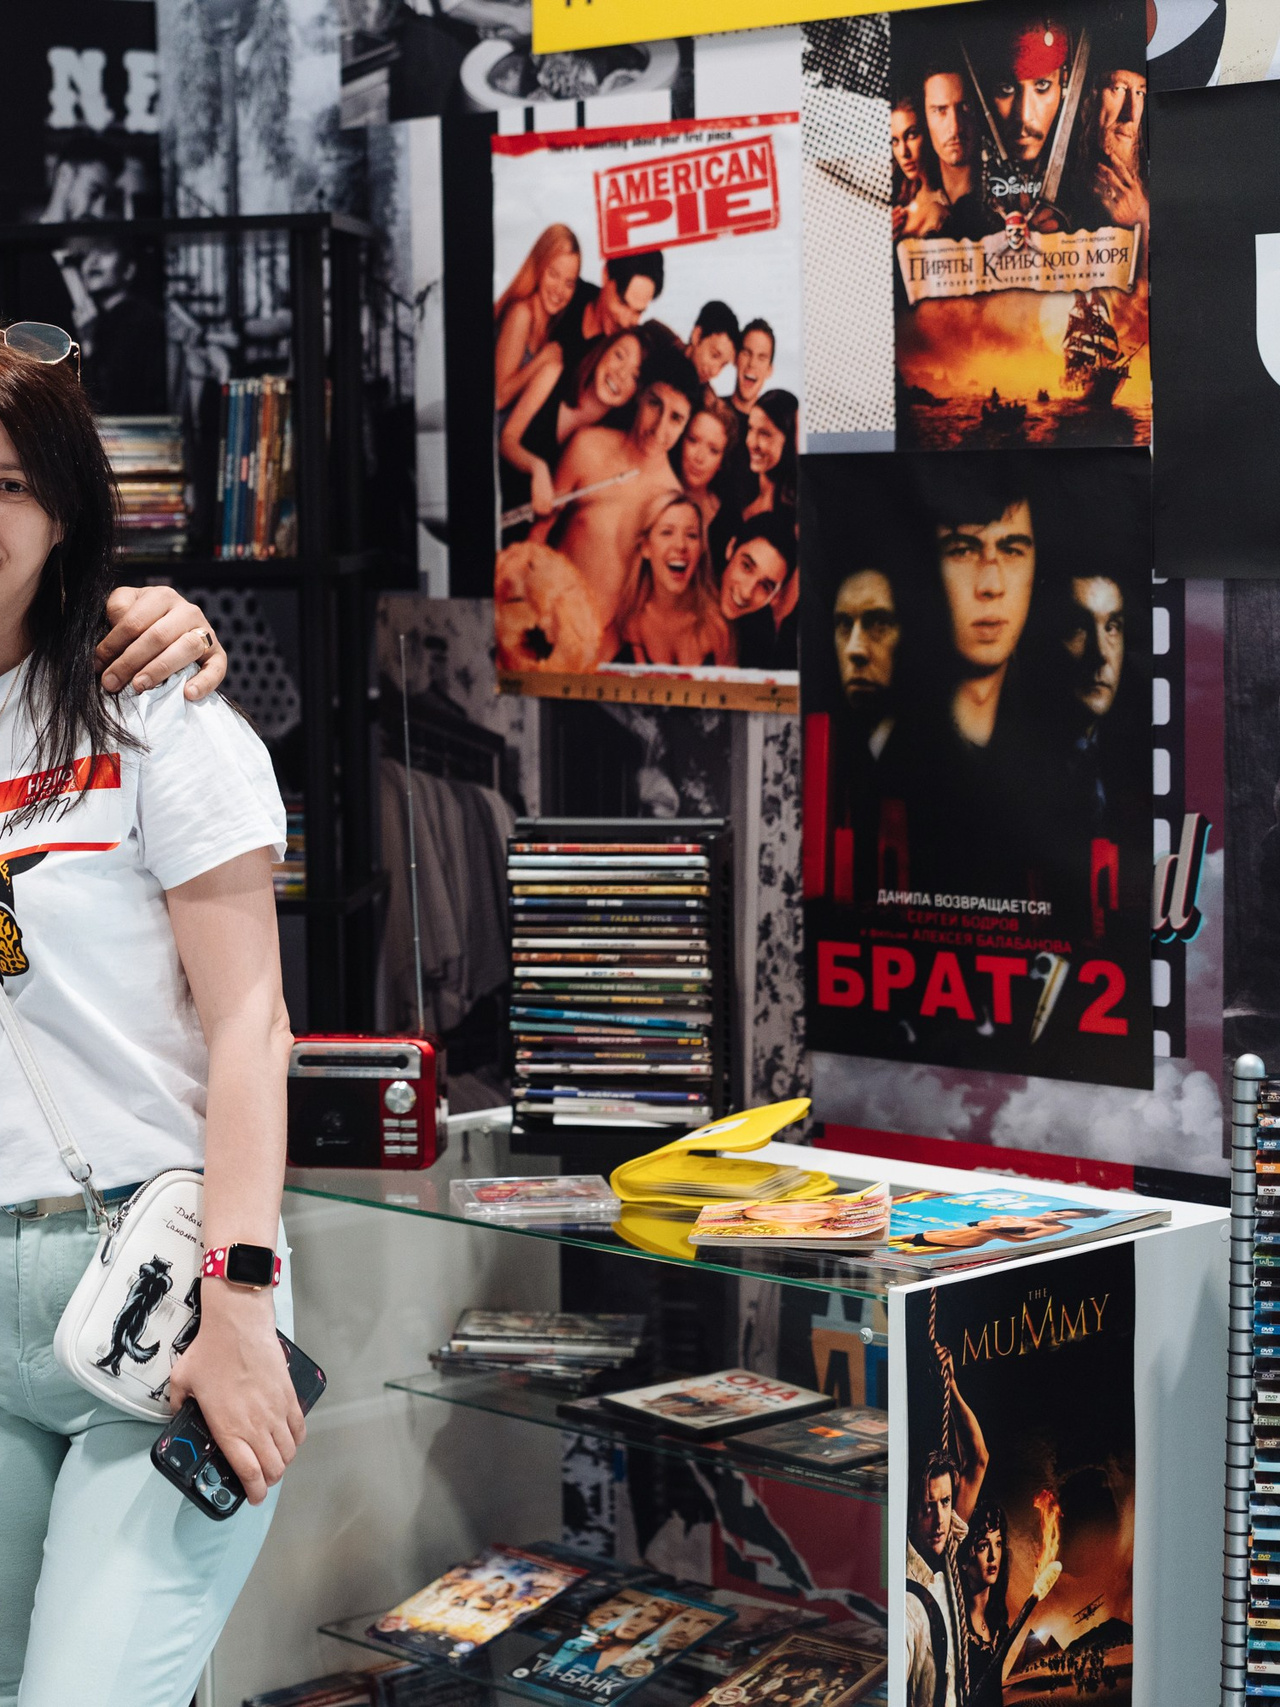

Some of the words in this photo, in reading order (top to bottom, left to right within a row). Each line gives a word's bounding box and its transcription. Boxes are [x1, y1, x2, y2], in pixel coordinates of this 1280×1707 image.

[632, 135, 657, 147] about
[605, 146, 768, 207] AMERICAN
[605, 178, 772, 249] PIE
[1086, 247, 1130, 266] МОРЯ
[877, 888, 932, 907] ДАНИЛА
[935, 893, 1052, 916] ВОЗВРАЩАЕТСЯ!
[907, 910, 959, 928] СЕРГЕЙ
[962, 914, 1020, 932] БОДРОВ
[912, 928, 973, 947] АЛЕКСЕЯ
[976, 934, 1073, 954] БАЛАБАНОВА
[816, 940, 1028, 1026] БРАТ
[1077, 958, 1129, 1037] 2
[1028, 1288, 1048, 1300] THE
[960, 1293, 1111, 1366] MUMMY
[726, 1374, 800, 1401] ОНА
